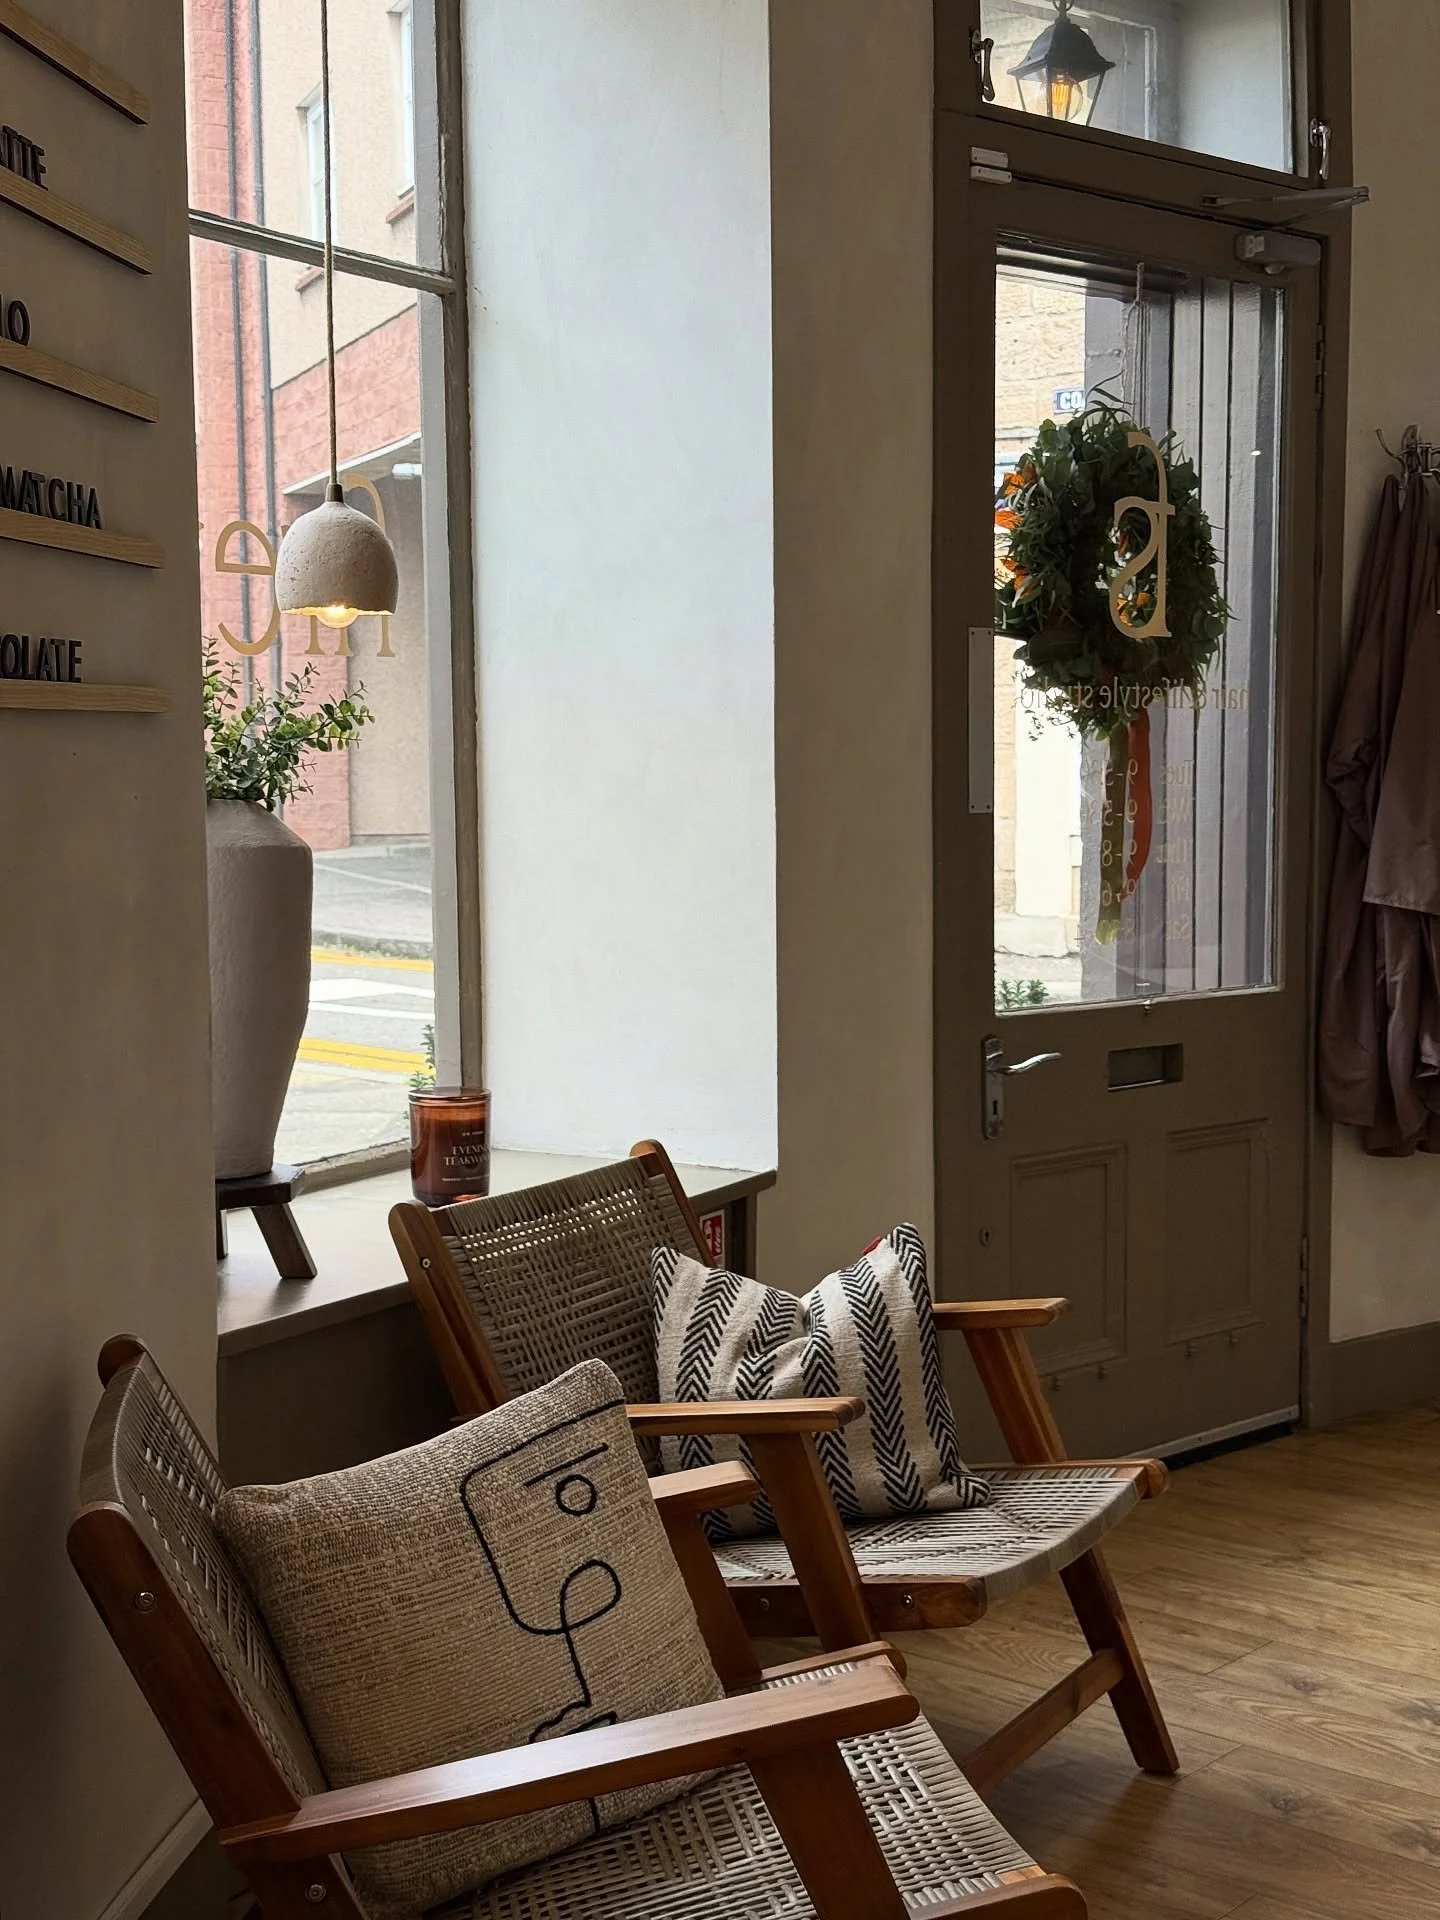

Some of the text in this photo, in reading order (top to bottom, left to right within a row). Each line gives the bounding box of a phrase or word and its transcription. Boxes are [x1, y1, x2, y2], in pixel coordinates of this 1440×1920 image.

[0, 125, 49, 191] TTE
[0, 294, 31, 346] O
[1059, 391, 1085, 410] CO
[0, 633, 83, 683] OLATE
